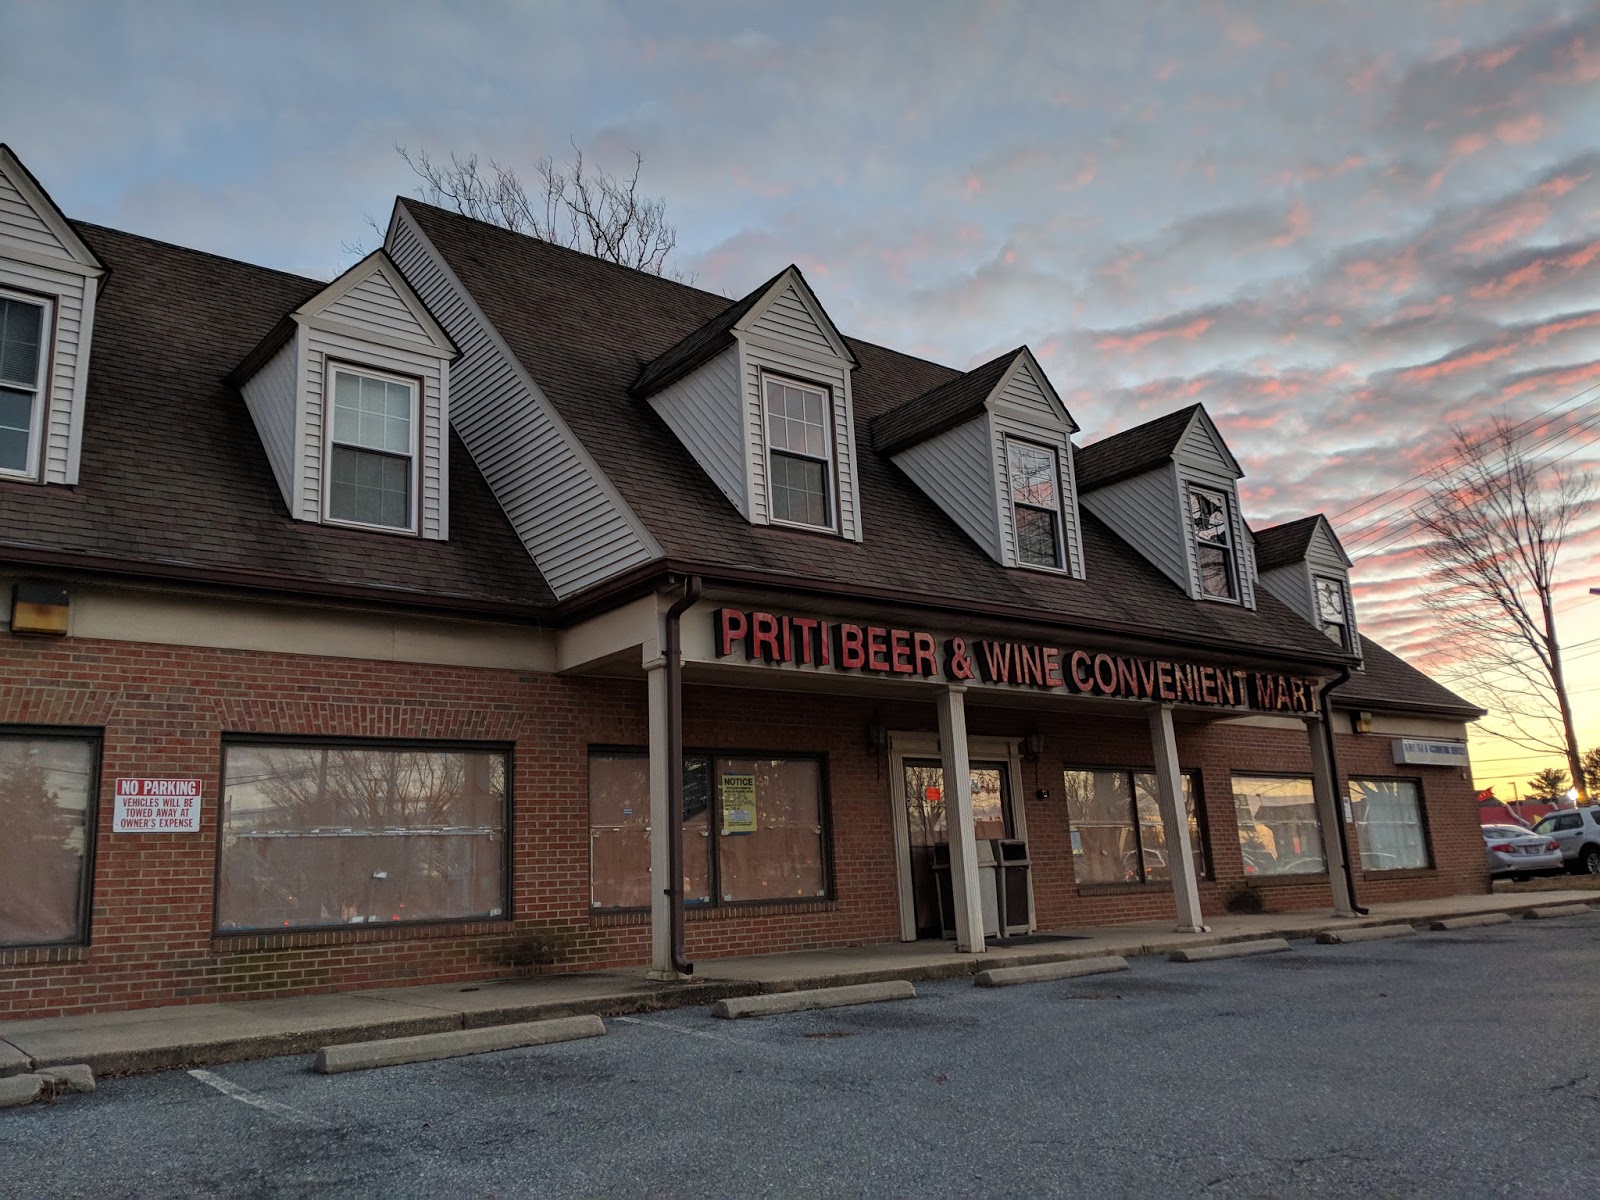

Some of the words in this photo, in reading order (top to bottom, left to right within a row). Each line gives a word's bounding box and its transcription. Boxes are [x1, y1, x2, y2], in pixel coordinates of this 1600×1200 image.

[715, 607, 829, 666] PRITI
[834, 623, 938, 676] BEER
[947, 636, 974, 680] &
[977, 639, 1063, 688] WINE
[1065, 649, 1247, 706] CONVENIENT
[1251, 672, 1319, 713] MART
[724, 777, 753, 786] NOTICE
[121, 780, 139, 795] NO
[143, 780, 196, 795] PARKING
[122, 797, 159, 807] VEHICLES
[163, 798, 180, 808] WILL
[184, 798, 193, 808] BE
[126, 808, 153, 818] TOWED
[155, 808, 177, 818] AWAY
[180, 808, 190, 818] AT
[120, 818, 156, 828] OWNER'S
[158, 818, 193, 828] EXPENSE
